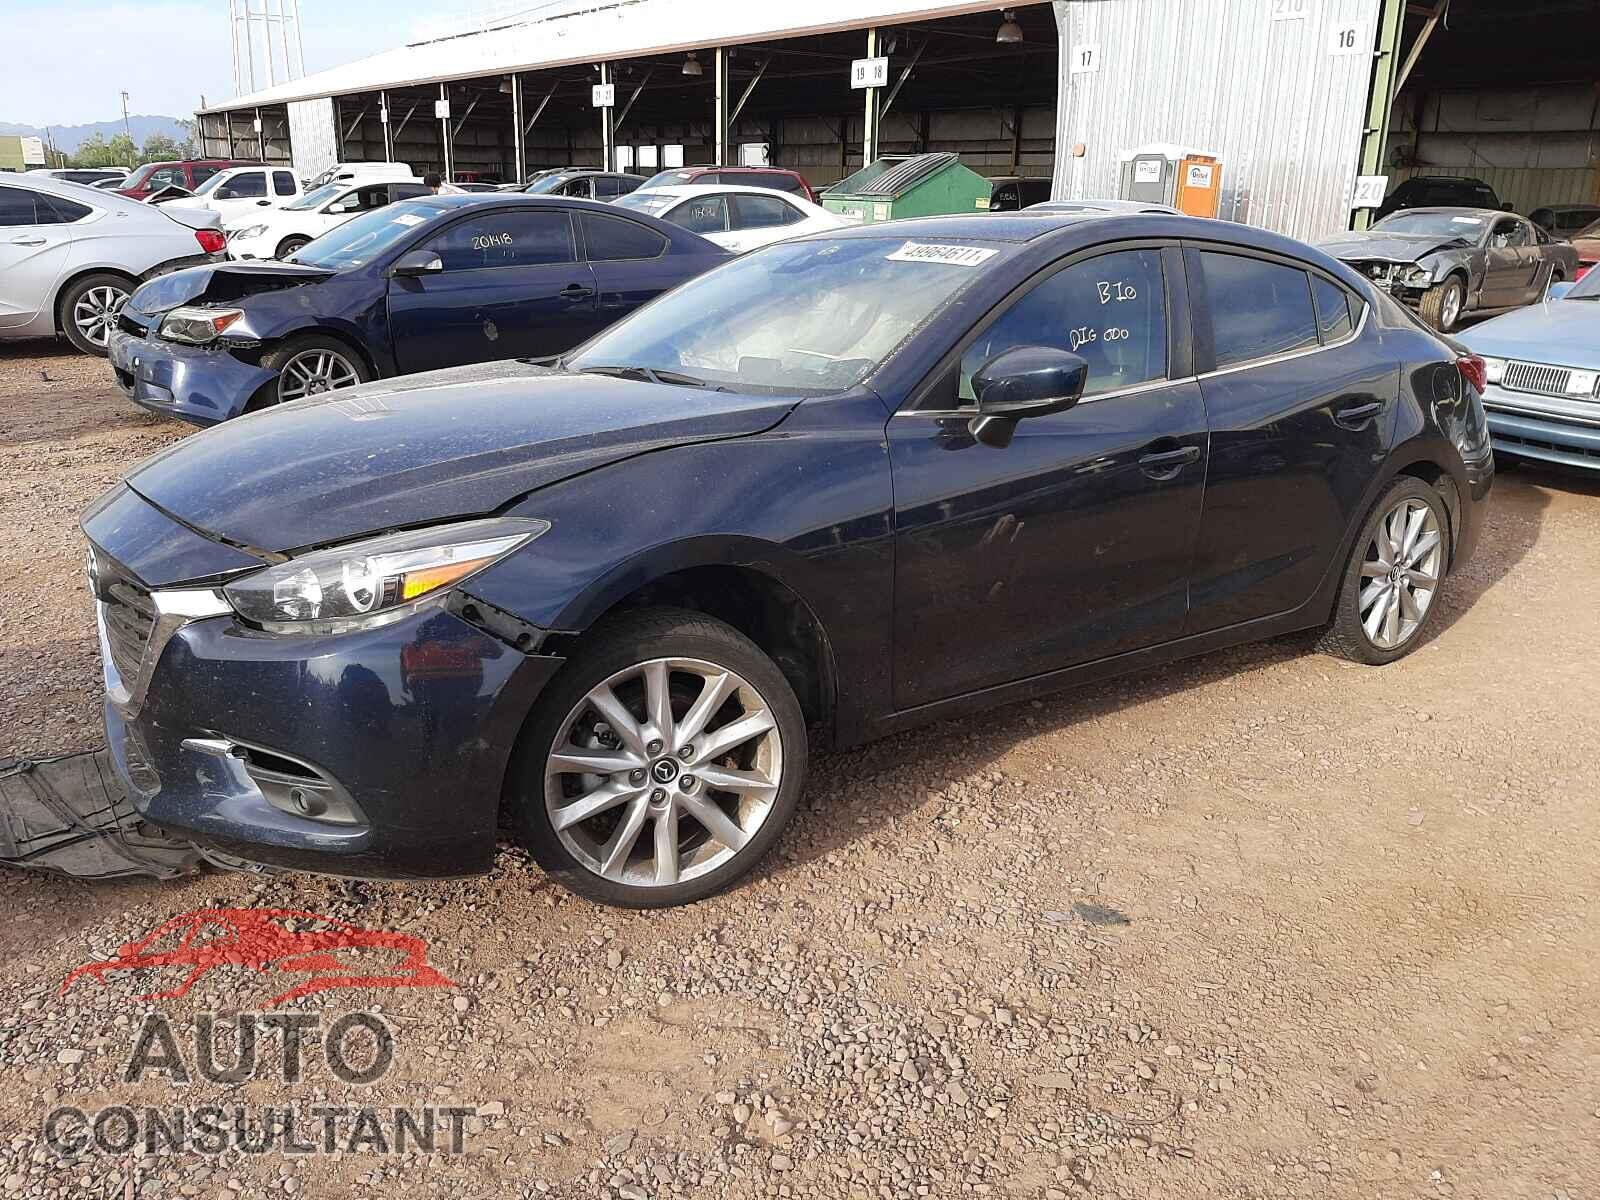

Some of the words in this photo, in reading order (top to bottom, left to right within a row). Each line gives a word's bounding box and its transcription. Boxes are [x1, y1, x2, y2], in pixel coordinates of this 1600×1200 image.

[1339, 29, 1355, 48] 16
[1081, 50, 1092, 66] 17
[857, 67, 865, 80] 19
[1356, 182, 1382, 200] 20
[1069, 326, 1097, 351] DIG
